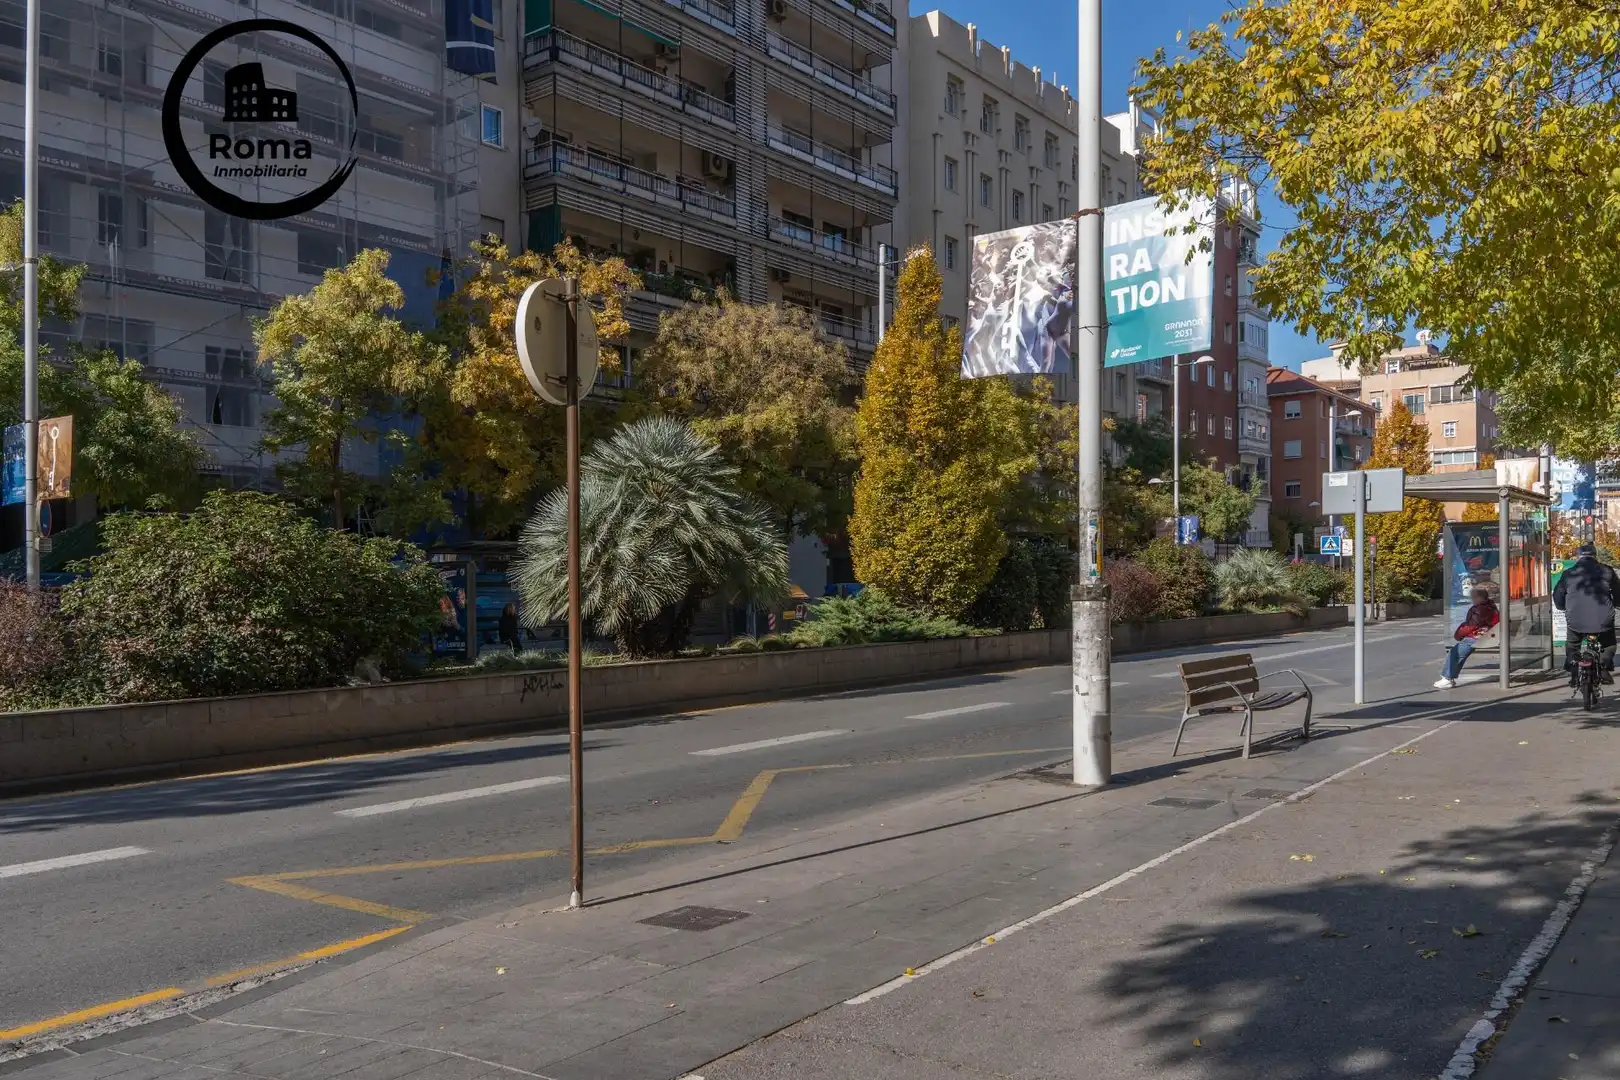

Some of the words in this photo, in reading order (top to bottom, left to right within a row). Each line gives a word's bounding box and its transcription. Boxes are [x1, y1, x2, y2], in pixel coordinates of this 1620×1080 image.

[3, 147, 81, 170] ALUISUR
[1110, 247, 1153, 281] RA
[1110, 275, 1186, 315] TION
[1174, 328, 1193, 339] 2031
